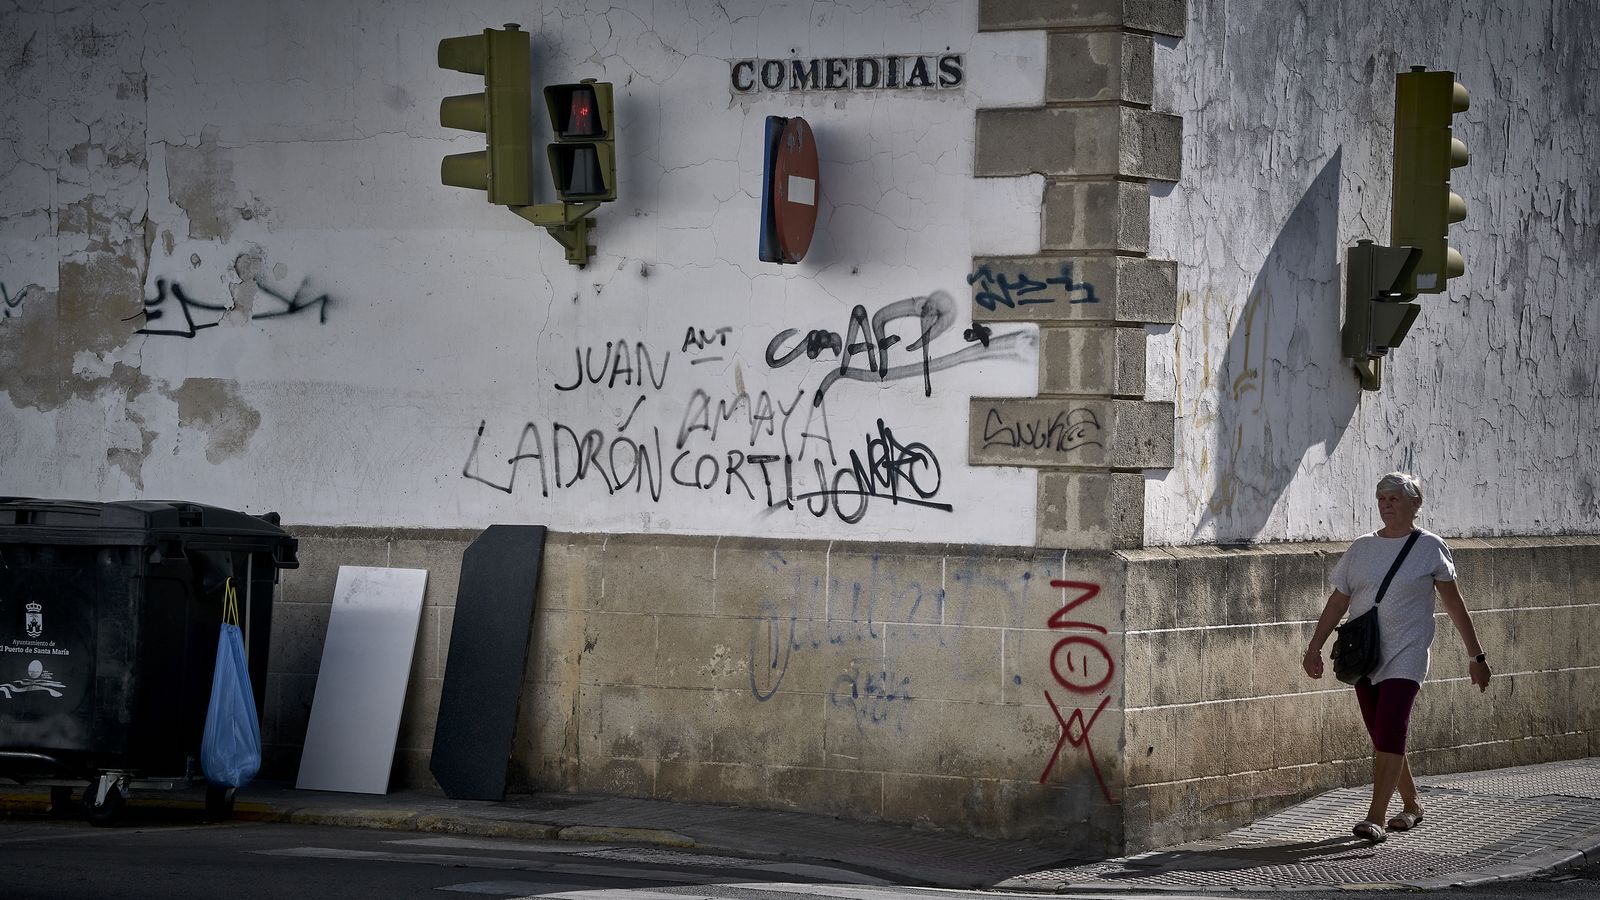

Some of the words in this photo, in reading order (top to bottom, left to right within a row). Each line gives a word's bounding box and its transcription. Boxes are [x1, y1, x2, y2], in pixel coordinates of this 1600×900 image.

[731, 55, 963, 91] COMEDIAS
[554, 338, 670, 391] JUAN
[463, 394, 663, 502] LADRÓN
[676, 388, 837, 466] AMAYA
[12, 639, 48, 647] Ayuntamiento
[33, 647, 51, 655] Santa
[52, 648, 70, 656] María
